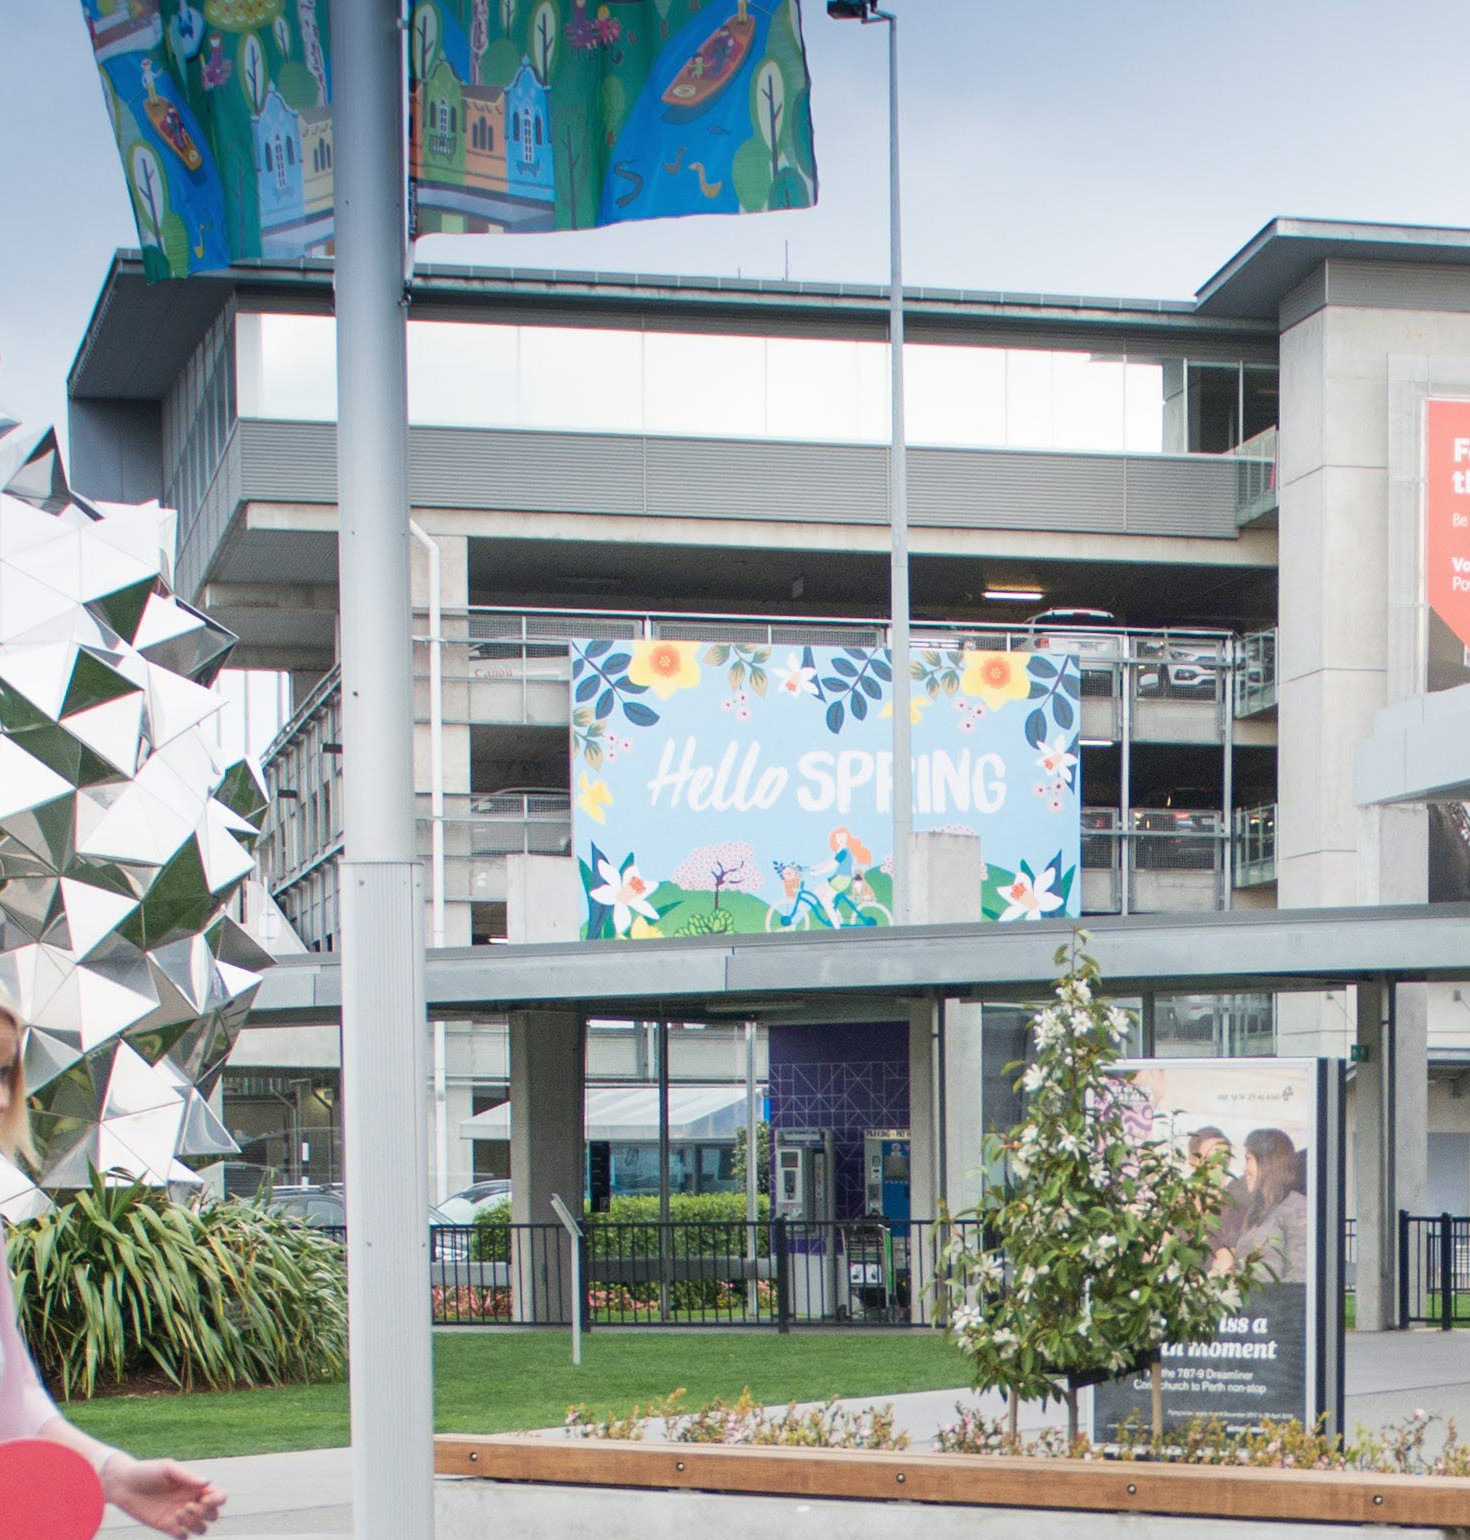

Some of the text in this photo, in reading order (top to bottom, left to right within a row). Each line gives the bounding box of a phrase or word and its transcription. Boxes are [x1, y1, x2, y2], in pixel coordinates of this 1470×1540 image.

[1452, 513, 1468, 528] Be
[474, 668, 514, 678] Canon
[647, 736, 788, 812] Hello
[1252, 1317, 1268, 1334] a
[1177, 1368, 1205, 1379] 787-9
[1191, 1382, 1200, 1391] to
[1201, 1381, 1226, 1392] Perth
[1227, 1383, 1267, 1395] non-stop
